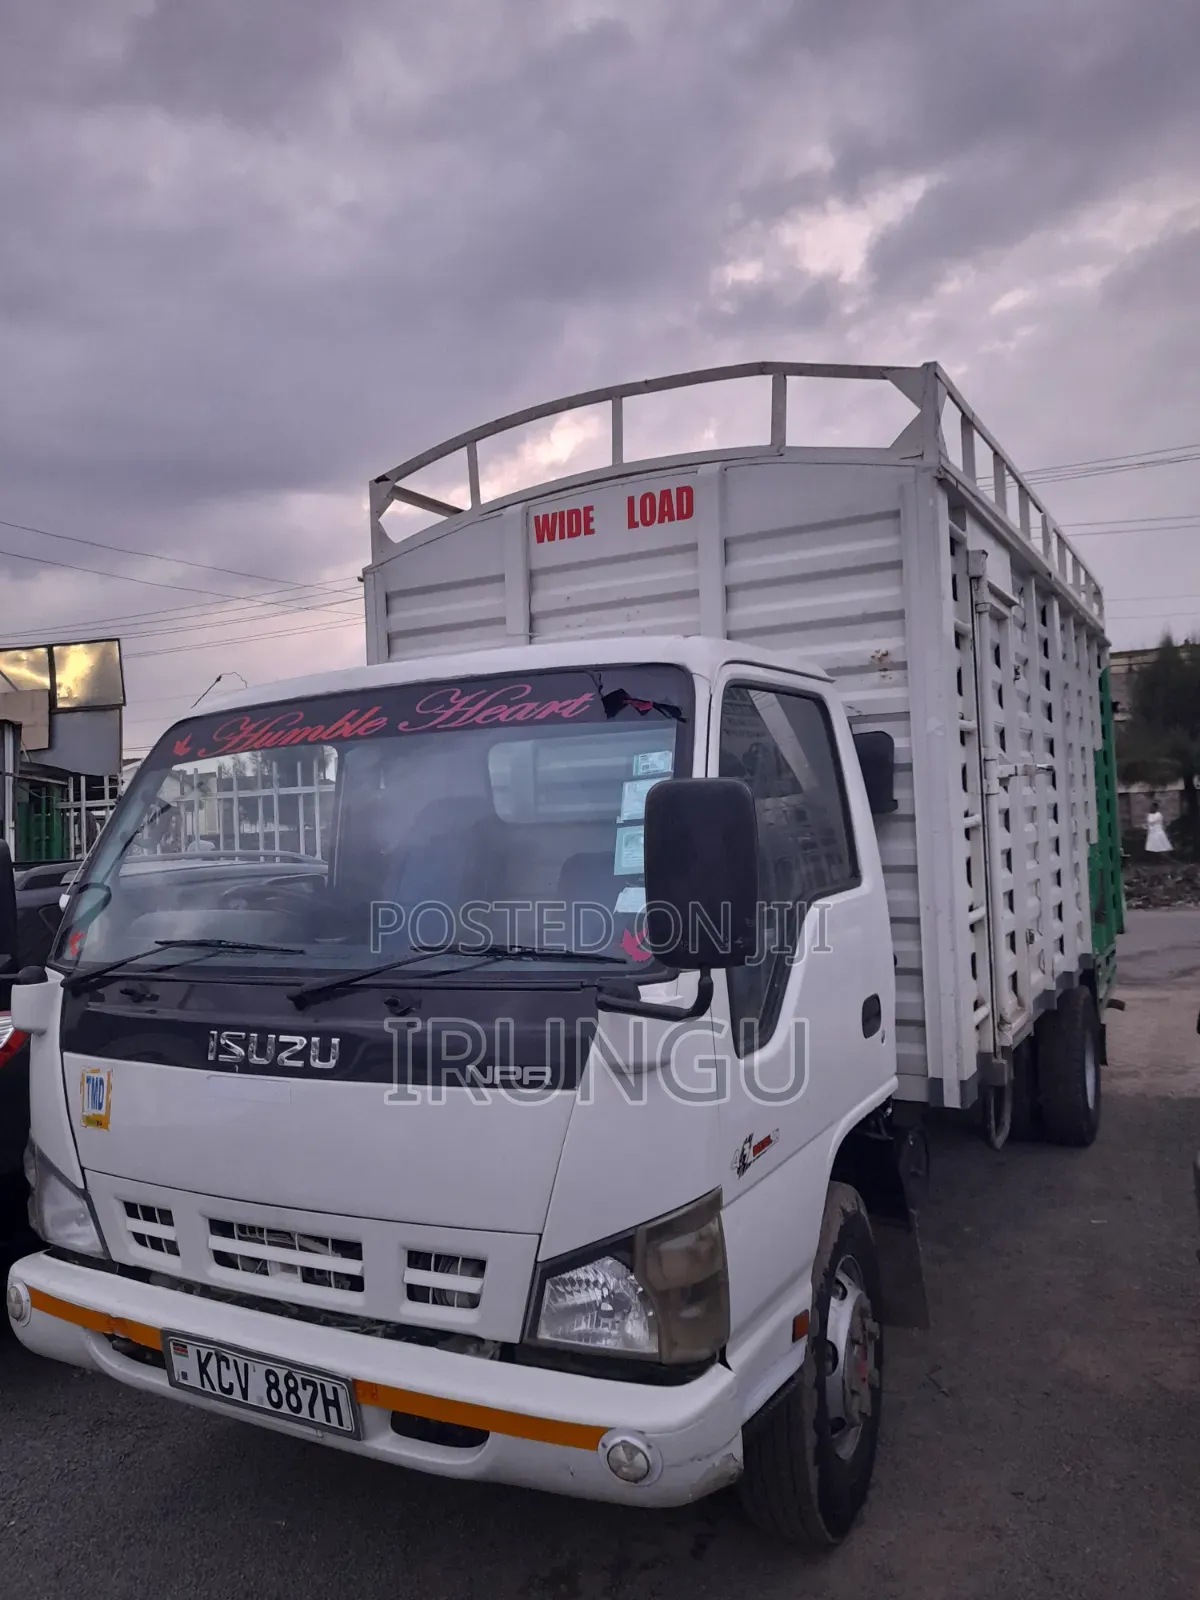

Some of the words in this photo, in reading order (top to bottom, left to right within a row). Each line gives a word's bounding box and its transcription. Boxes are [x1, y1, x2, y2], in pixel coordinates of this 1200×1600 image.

[534, 505, 595, 544] WIDE
[627, 485, 694, 529] LOAD
[198, 706, 387, 757] Humble
[398, 683, 597, 731] Heart
[207, 1030, 341, 1069] ISUZU
[465, 1064, 552, 1087] NPR
[196, 1349, 250, 1402] KCV
[264, 1368, 344, 1427] 887H
